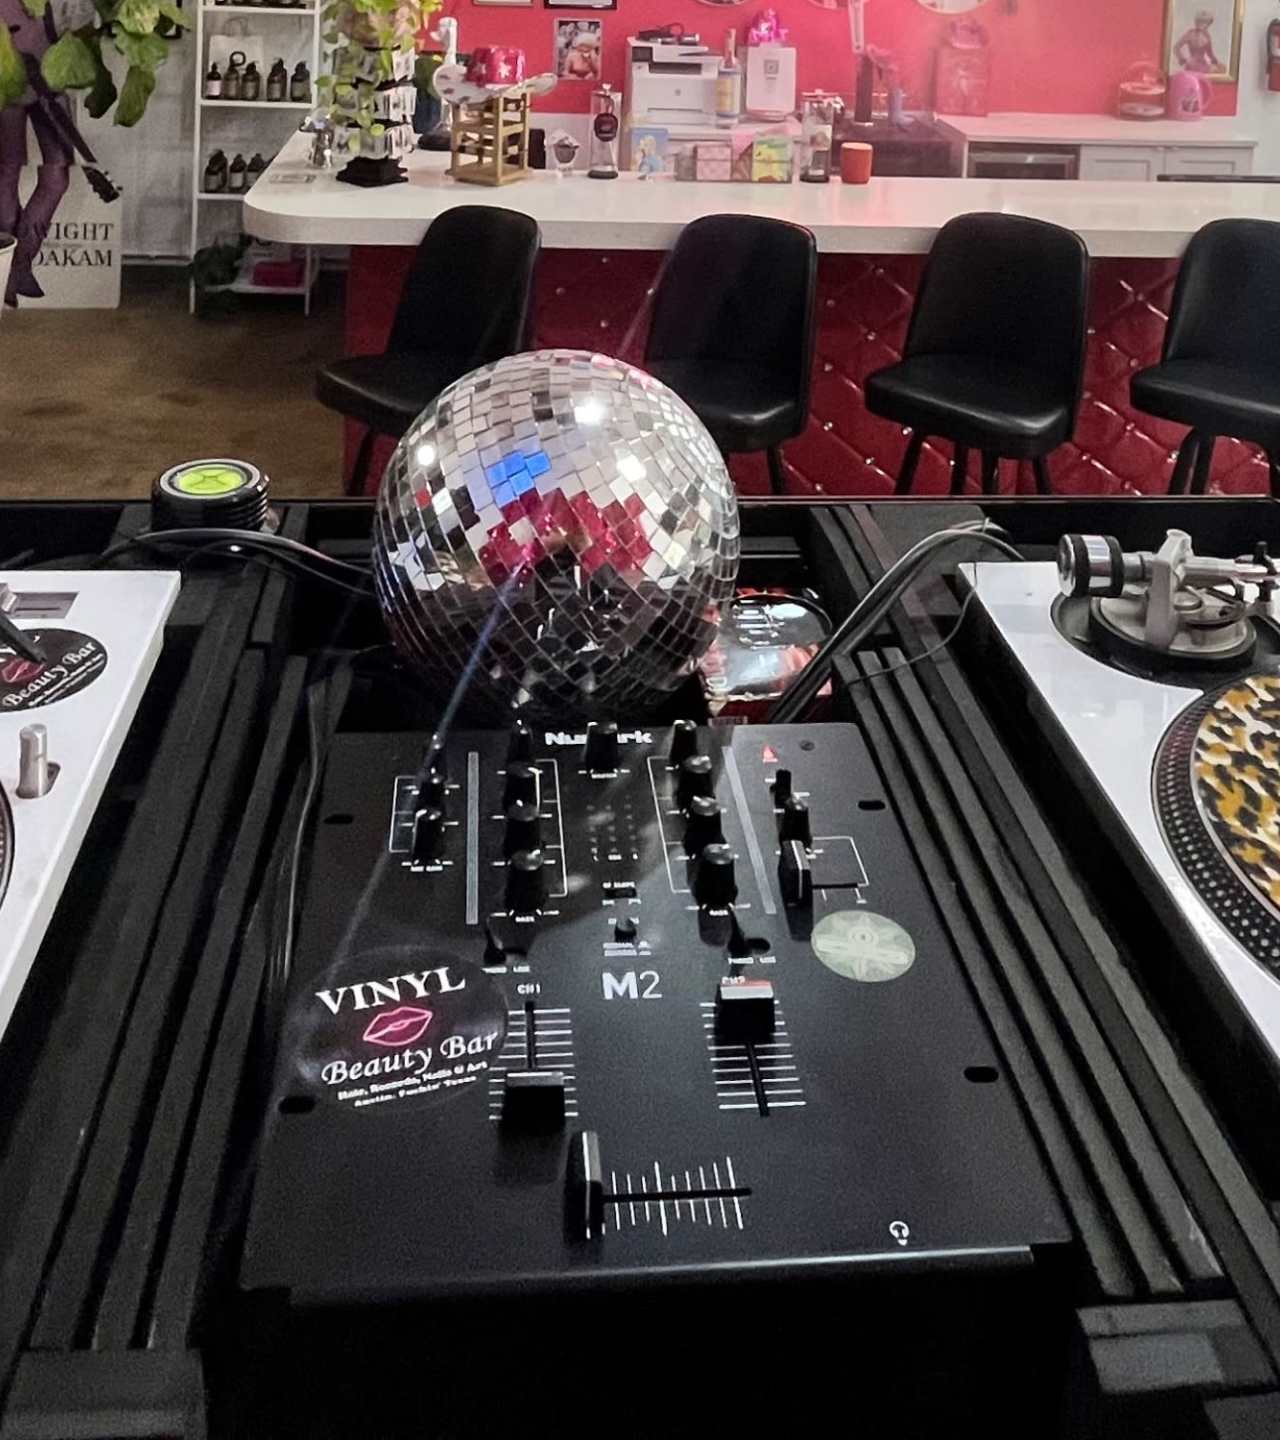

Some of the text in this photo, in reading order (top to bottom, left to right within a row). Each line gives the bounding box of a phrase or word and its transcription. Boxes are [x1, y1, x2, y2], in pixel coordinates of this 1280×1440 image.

[50, 221, 114, 241] IGHT
[2, 664, 67, 708] Beauty
[64, 641, 98, 667] Bar
[545, 731, 653, 745] Numrk
[314, 965, 467, 1016] VINYL
[601, 970, 664, 1001] M2
[320, 1032, 499, 1085] Beauty Bar
